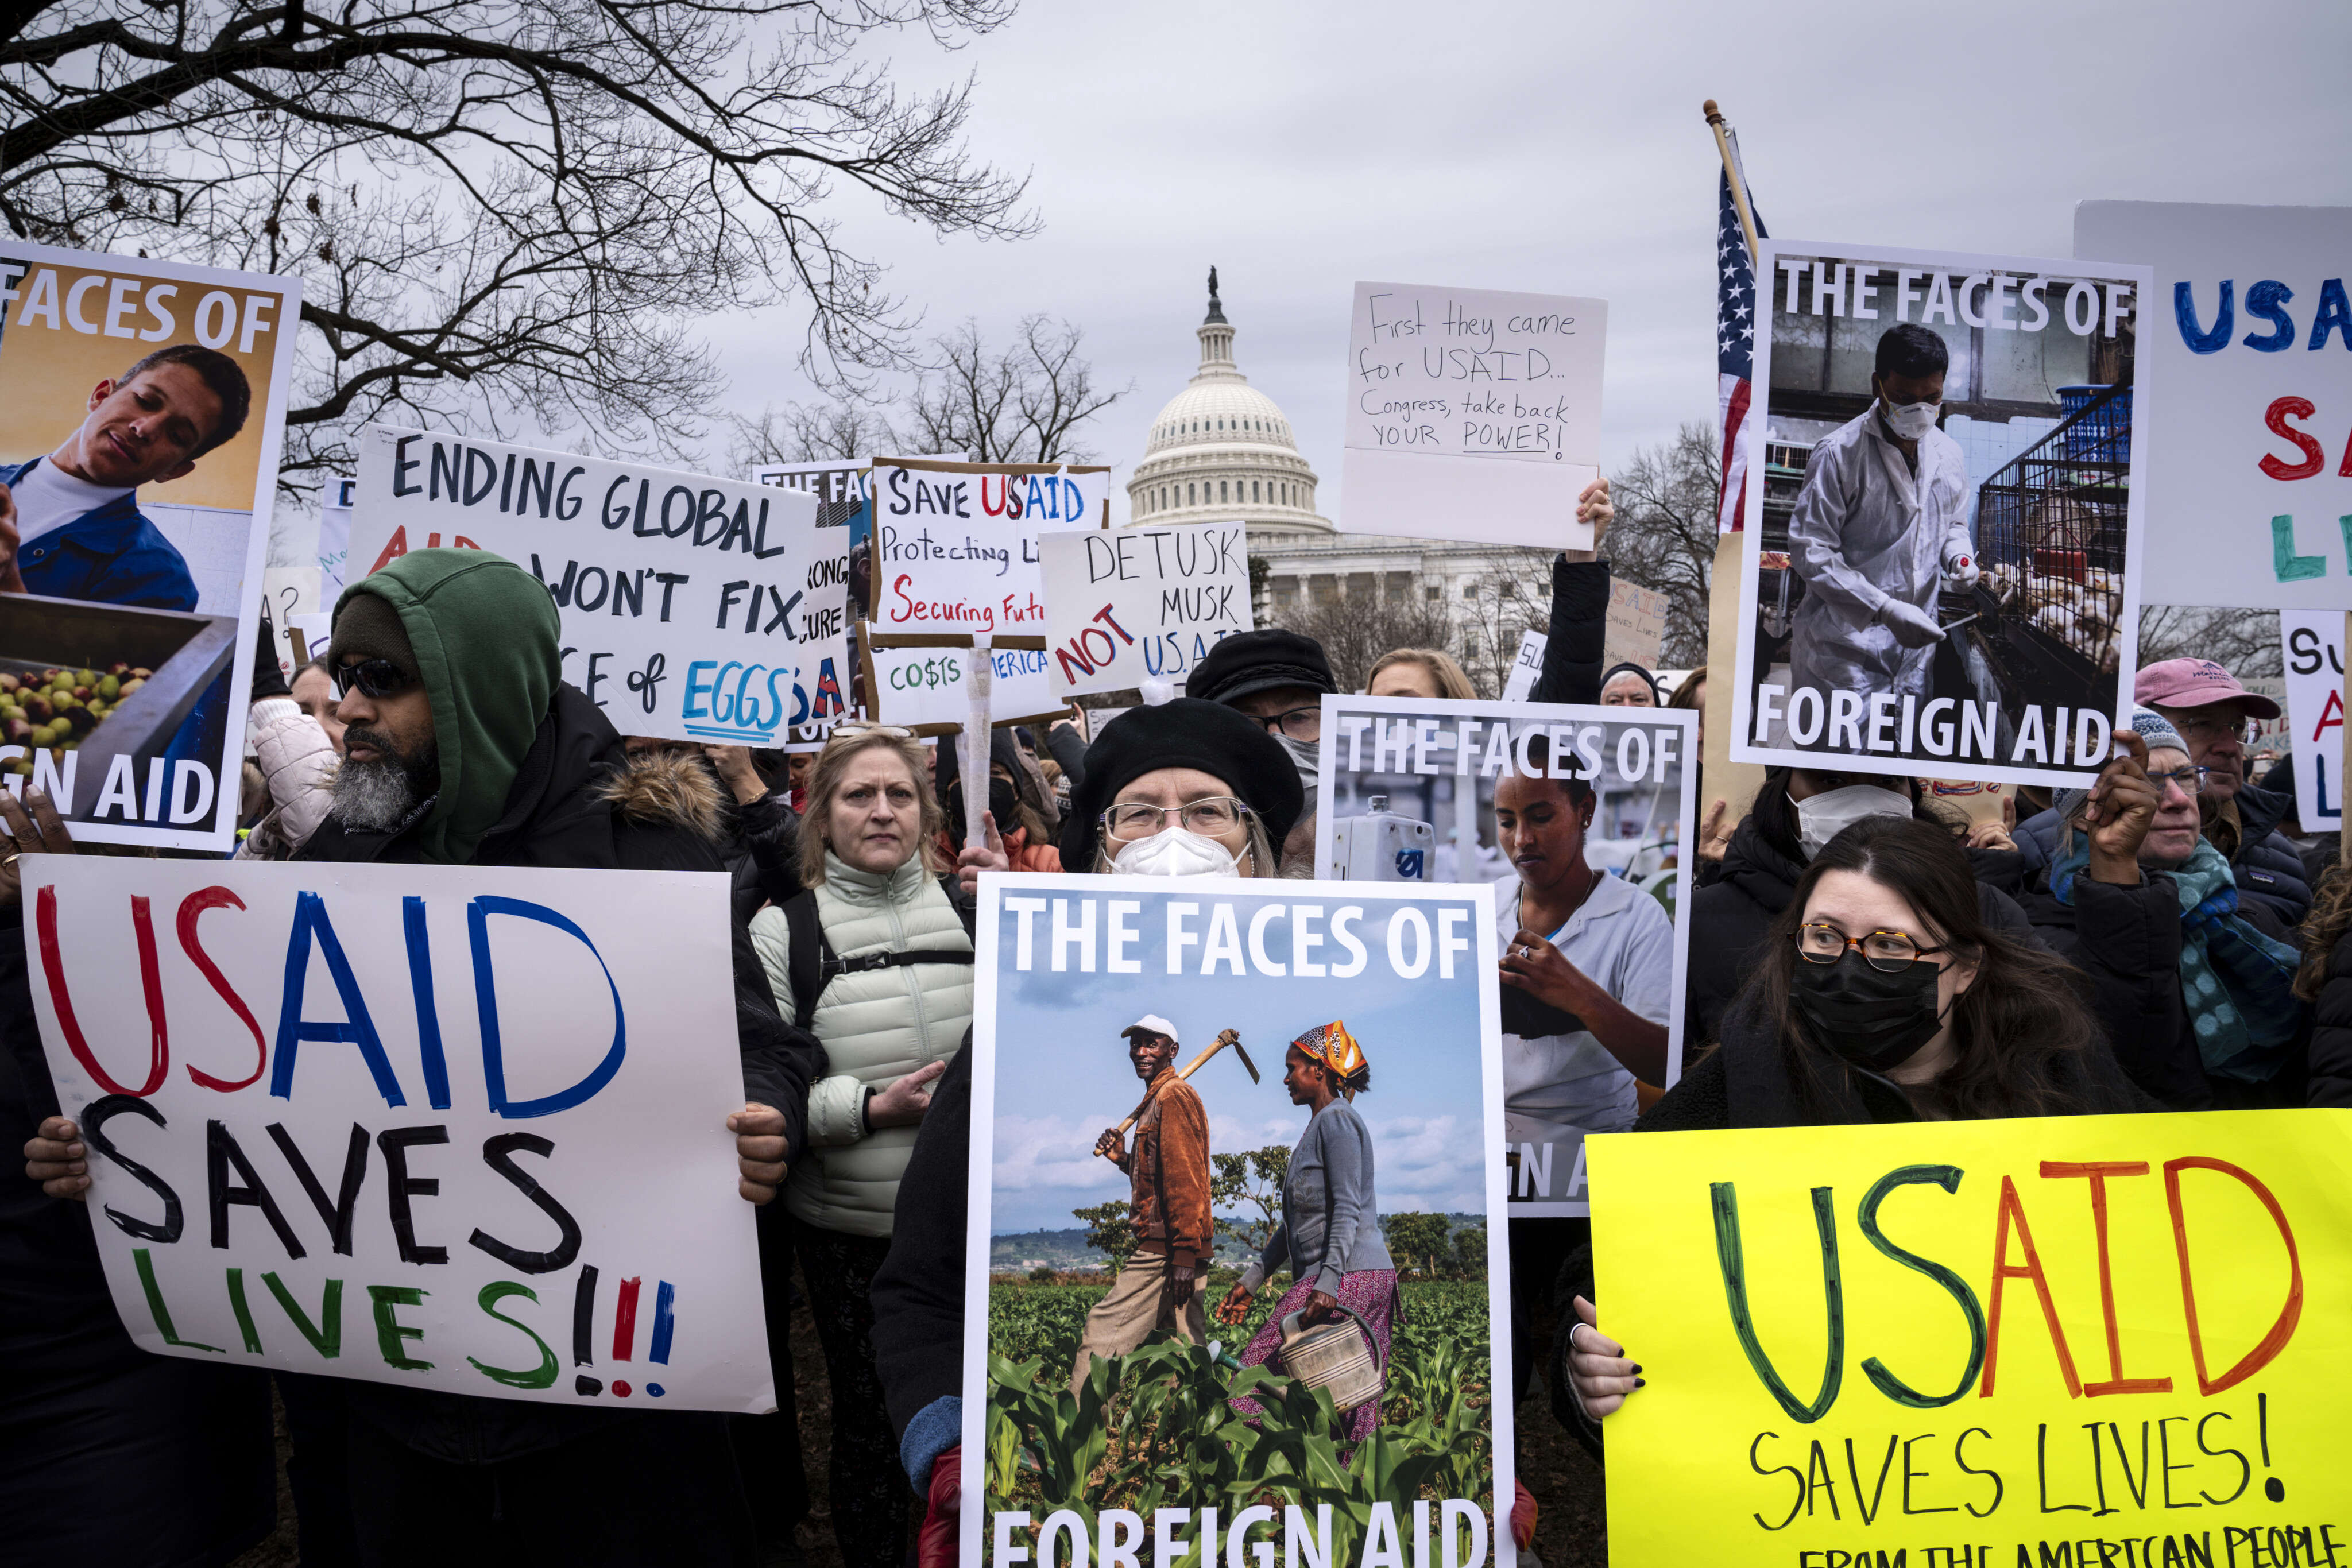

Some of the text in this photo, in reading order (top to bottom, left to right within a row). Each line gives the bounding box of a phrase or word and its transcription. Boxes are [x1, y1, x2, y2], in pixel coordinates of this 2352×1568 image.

[194, 290, 274, 353] OF
[1370, 294, 1576, 354] First they came
[1778, 259, 2130, 338] THE FACES OF
[1360, 346, 1565, 382] for USAID...
[1361, 389, 1569, 423] Congress, take back
[1373, 422, 1562, 460] YOUR POWER!
[394, 433, 784, 560] ENDING GLOBAL
[889, 469, 1084, 523] SAVE USAID
[882, 526, 1009, 576] Protecting
[531, 553, 803, 641] WON'T FIX
[891, 574, 995, 633] Securing
[1162, 584, 1238, 626] MUSK
[890, 656, 961, 690] CO$TS
[1055, 602, 1135, 686] NOT
[627, 652, 667, 714] of
[682, 660, 790, 731] EGGS
[1755, 684, 1997, 759] FOREIGN
[2011, 704, 2111, 766] AID
[1341, 716, 1678, 783] THE FACES OF
[94, 754, 215, 824] AID
[1005, 897, 1469, 980] THE FACES OF
[36, 884, 626, 1119] USAID
[80, 1094, 582, 1275] SAVES
[1708, 1155, 2303, 1424] USAID
[1749, 1392, 2285, 1531] SAVES LIVES!
[992, 1498, 1487, 1568] FOREIGN AID
